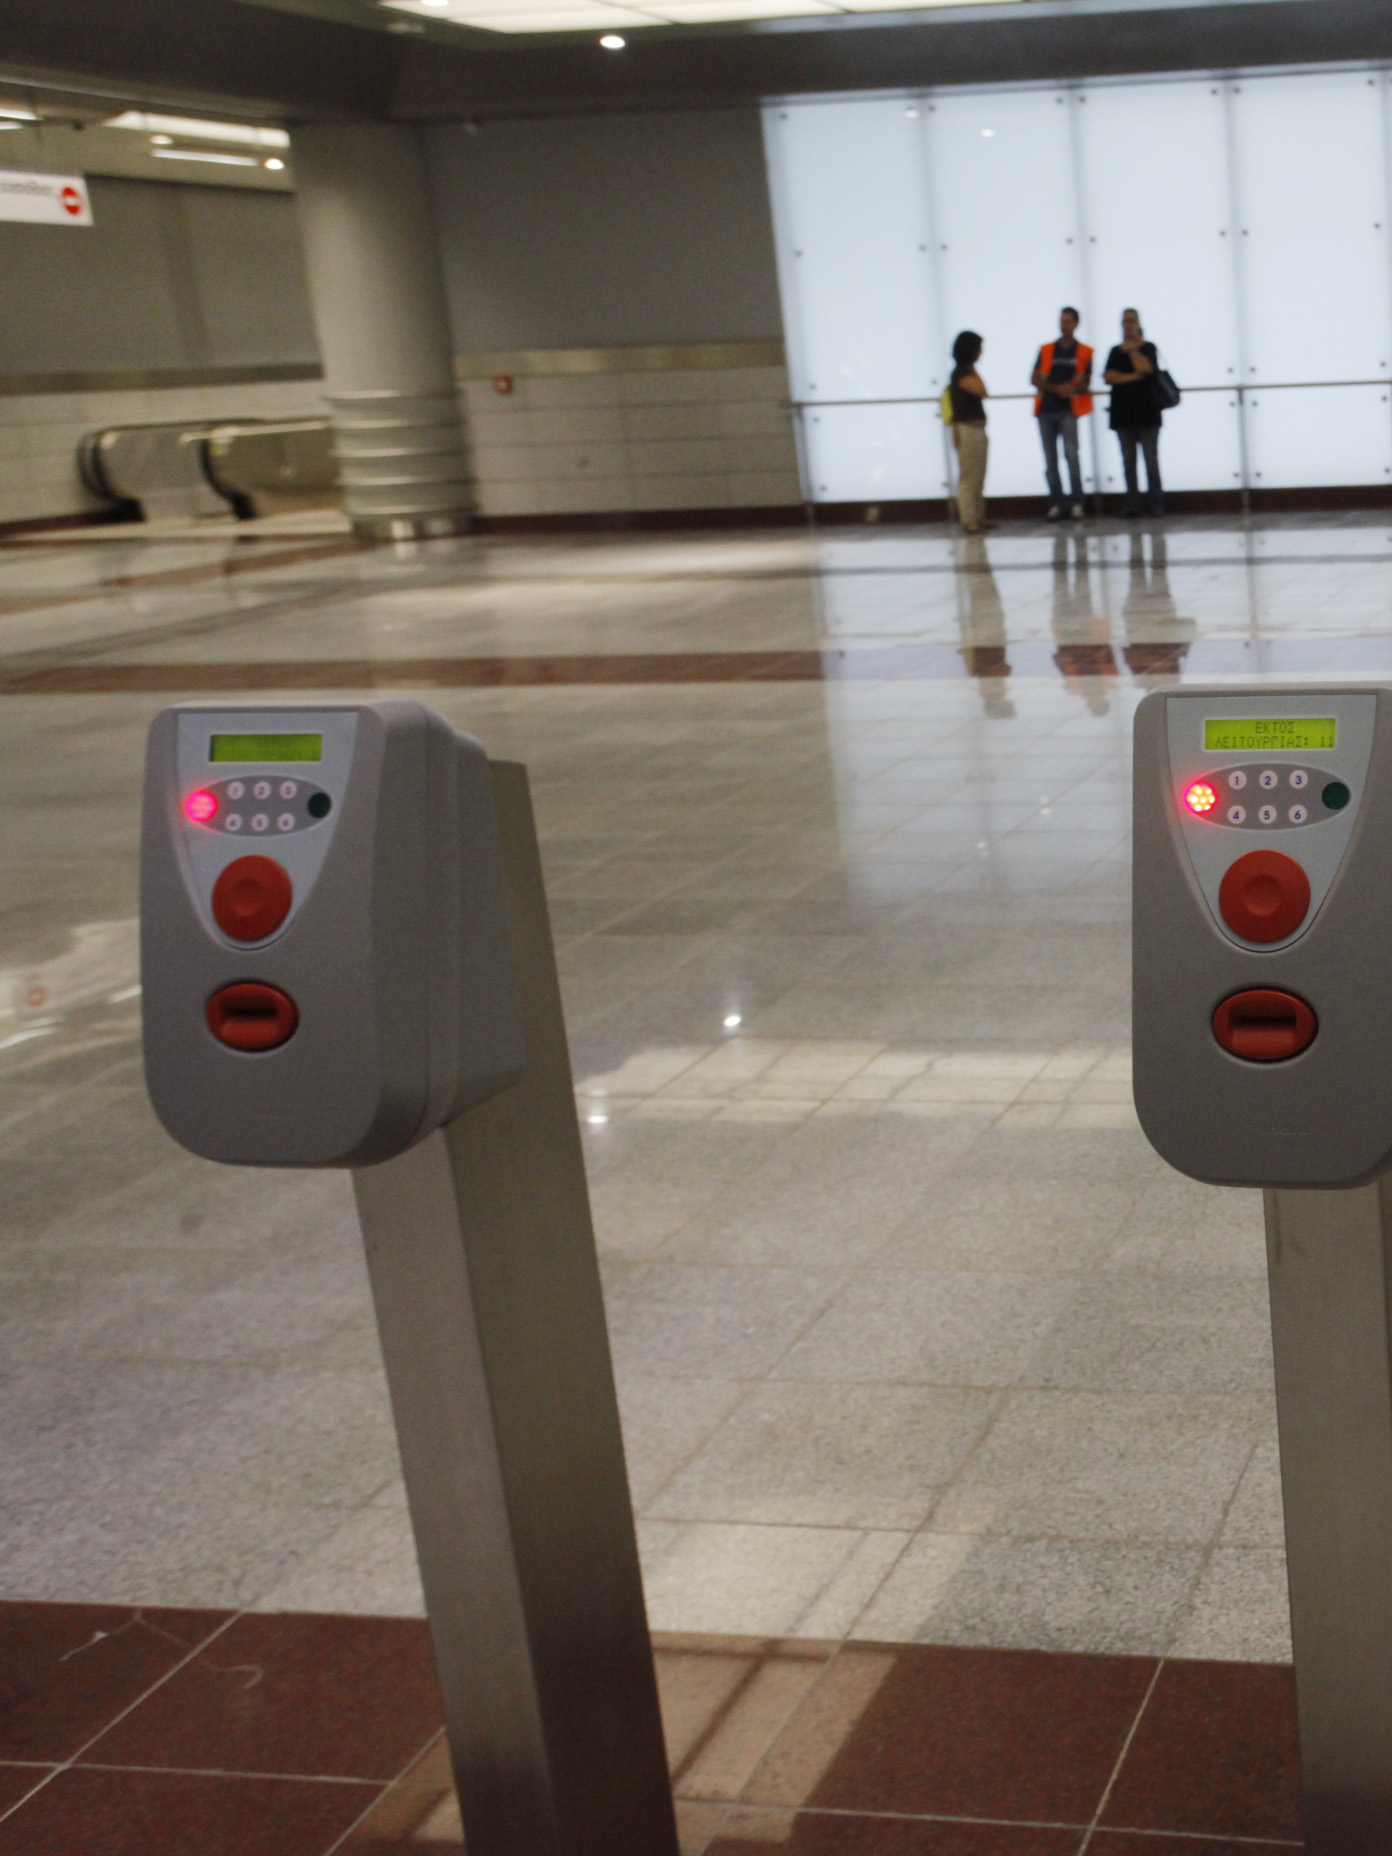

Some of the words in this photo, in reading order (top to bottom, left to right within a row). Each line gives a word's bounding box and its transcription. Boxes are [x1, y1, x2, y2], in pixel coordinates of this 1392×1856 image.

[1255, 721, 1296, 734] ΕΚΤΟΣ
[1320, 736, 1333, 748] 11
[1264, 776, 1271, 785] 2
[1295, 775, 1302, 785] 3
[1232, 810, 1239, 820] 4
[1264, 810, 1270, 820] 5
[1294, 810, 1301, 820] 6
